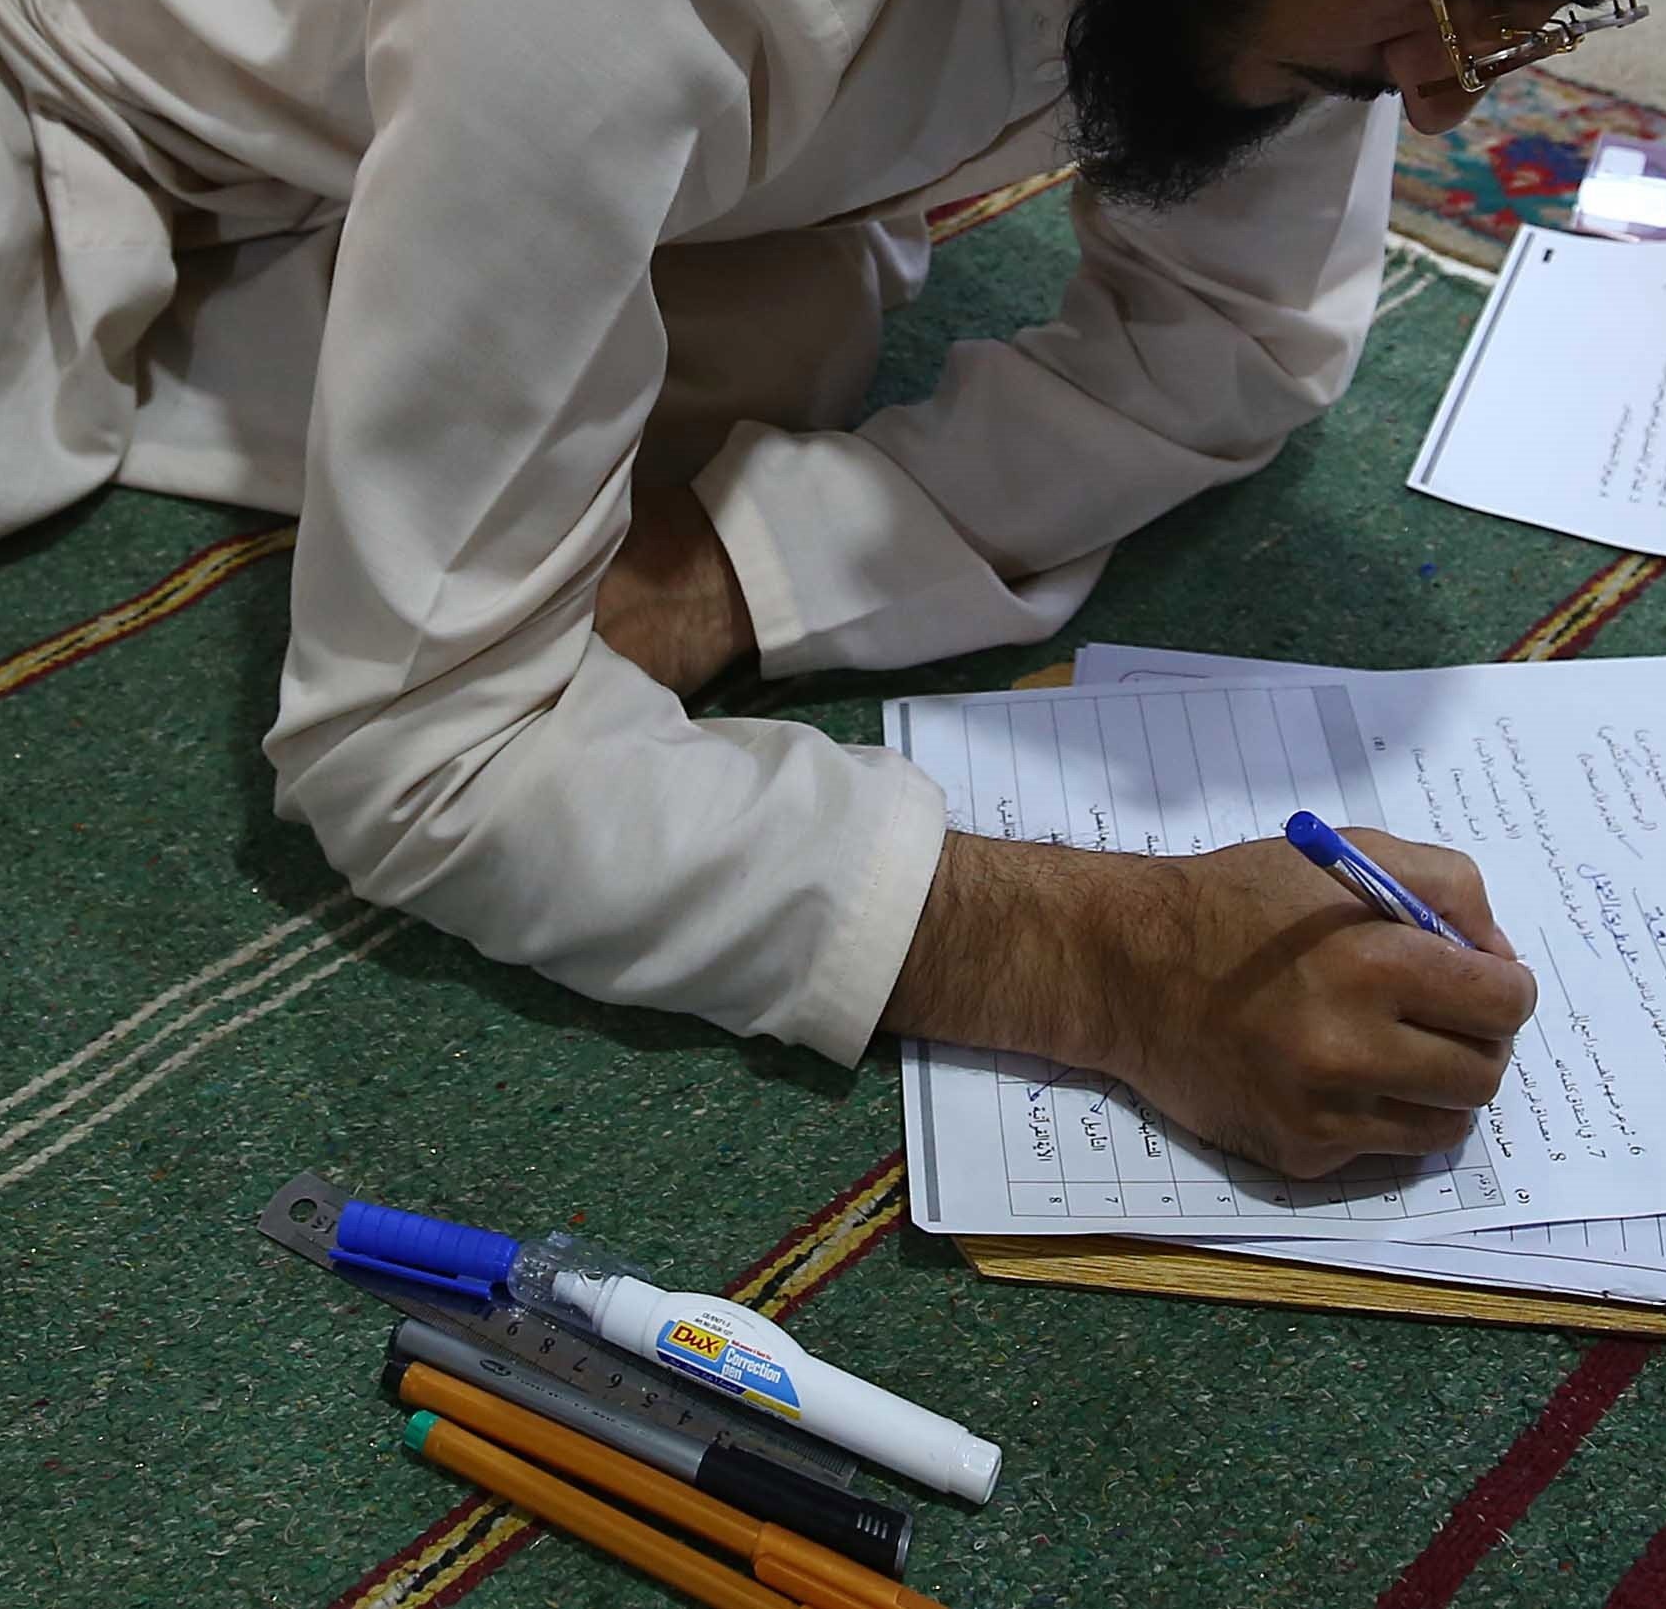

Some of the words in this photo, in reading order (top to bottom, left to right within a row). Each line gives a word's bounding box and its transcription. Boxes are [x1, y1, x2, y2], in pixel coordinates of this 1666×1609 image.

[1047, 1196, 1062, 1204] 8
[1103, 1196, 1119, 1204] 7
[1160, 1195, 1174, 1204] 6
[1215, 1195, 1231, 1203] 5
[1380, 1192, 1398, 1203] 2
[538, 1337, 556, 1355] 8
[725, 1347, 782, 1384] Correction
[720, 1364, 742, 1382] pen
